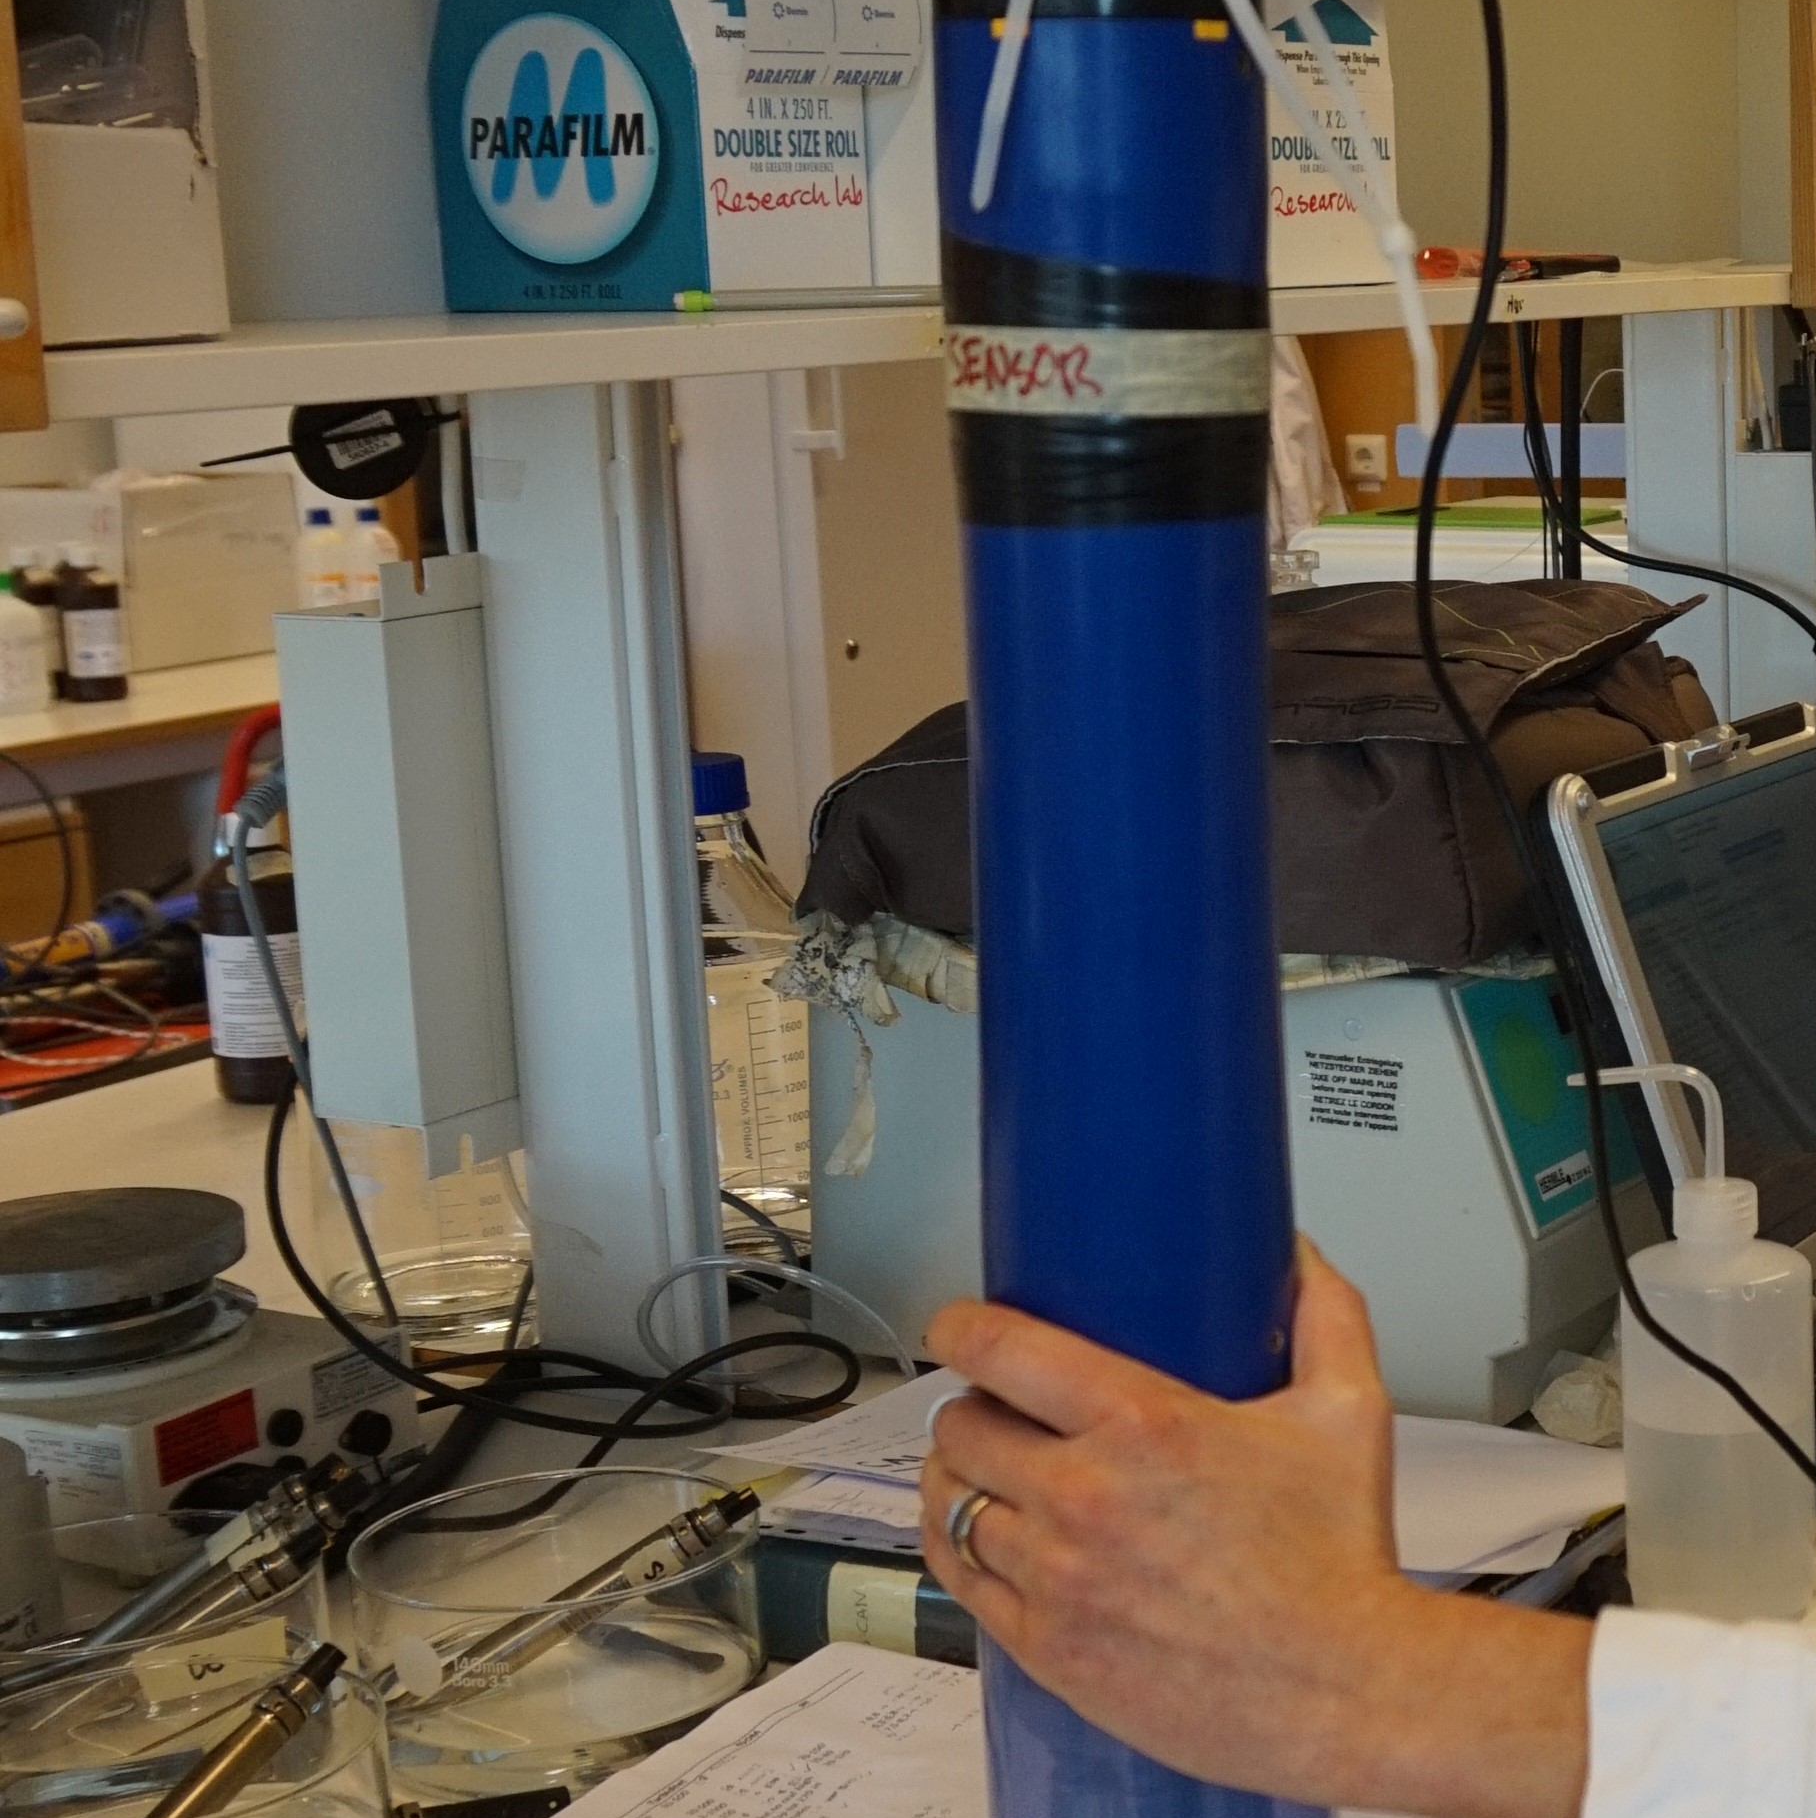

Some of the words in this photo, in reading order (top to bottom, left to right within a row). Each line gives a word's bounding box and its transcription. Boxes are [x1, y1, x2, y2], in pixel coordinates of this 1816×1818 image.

[744, 69, 817, 85] PARAFILM
[832, 69, 903, 86] PARAFILM
[746, 97, 755, 120] 4
[759, 97, 777, 120] IN.
[781, 98, 789, 120] X
[793, 98, 814, 120] 250
[817, 98, 833, 120] FT.
[470, 113, 645, 160] PARAFILM
[714, 128, 783, 158] DOUBLE
[789, 129, 821, 158] SIZE
[826, 129, 860, 158] ROLL
[710, 177, 830, 217] Research
[835, 174, 863, 207] lab
[780, 1019, 803, 1033] 1600
[782, 1049, 805, 1064] 1400
[784, 1079, 807, 1094] 1200
